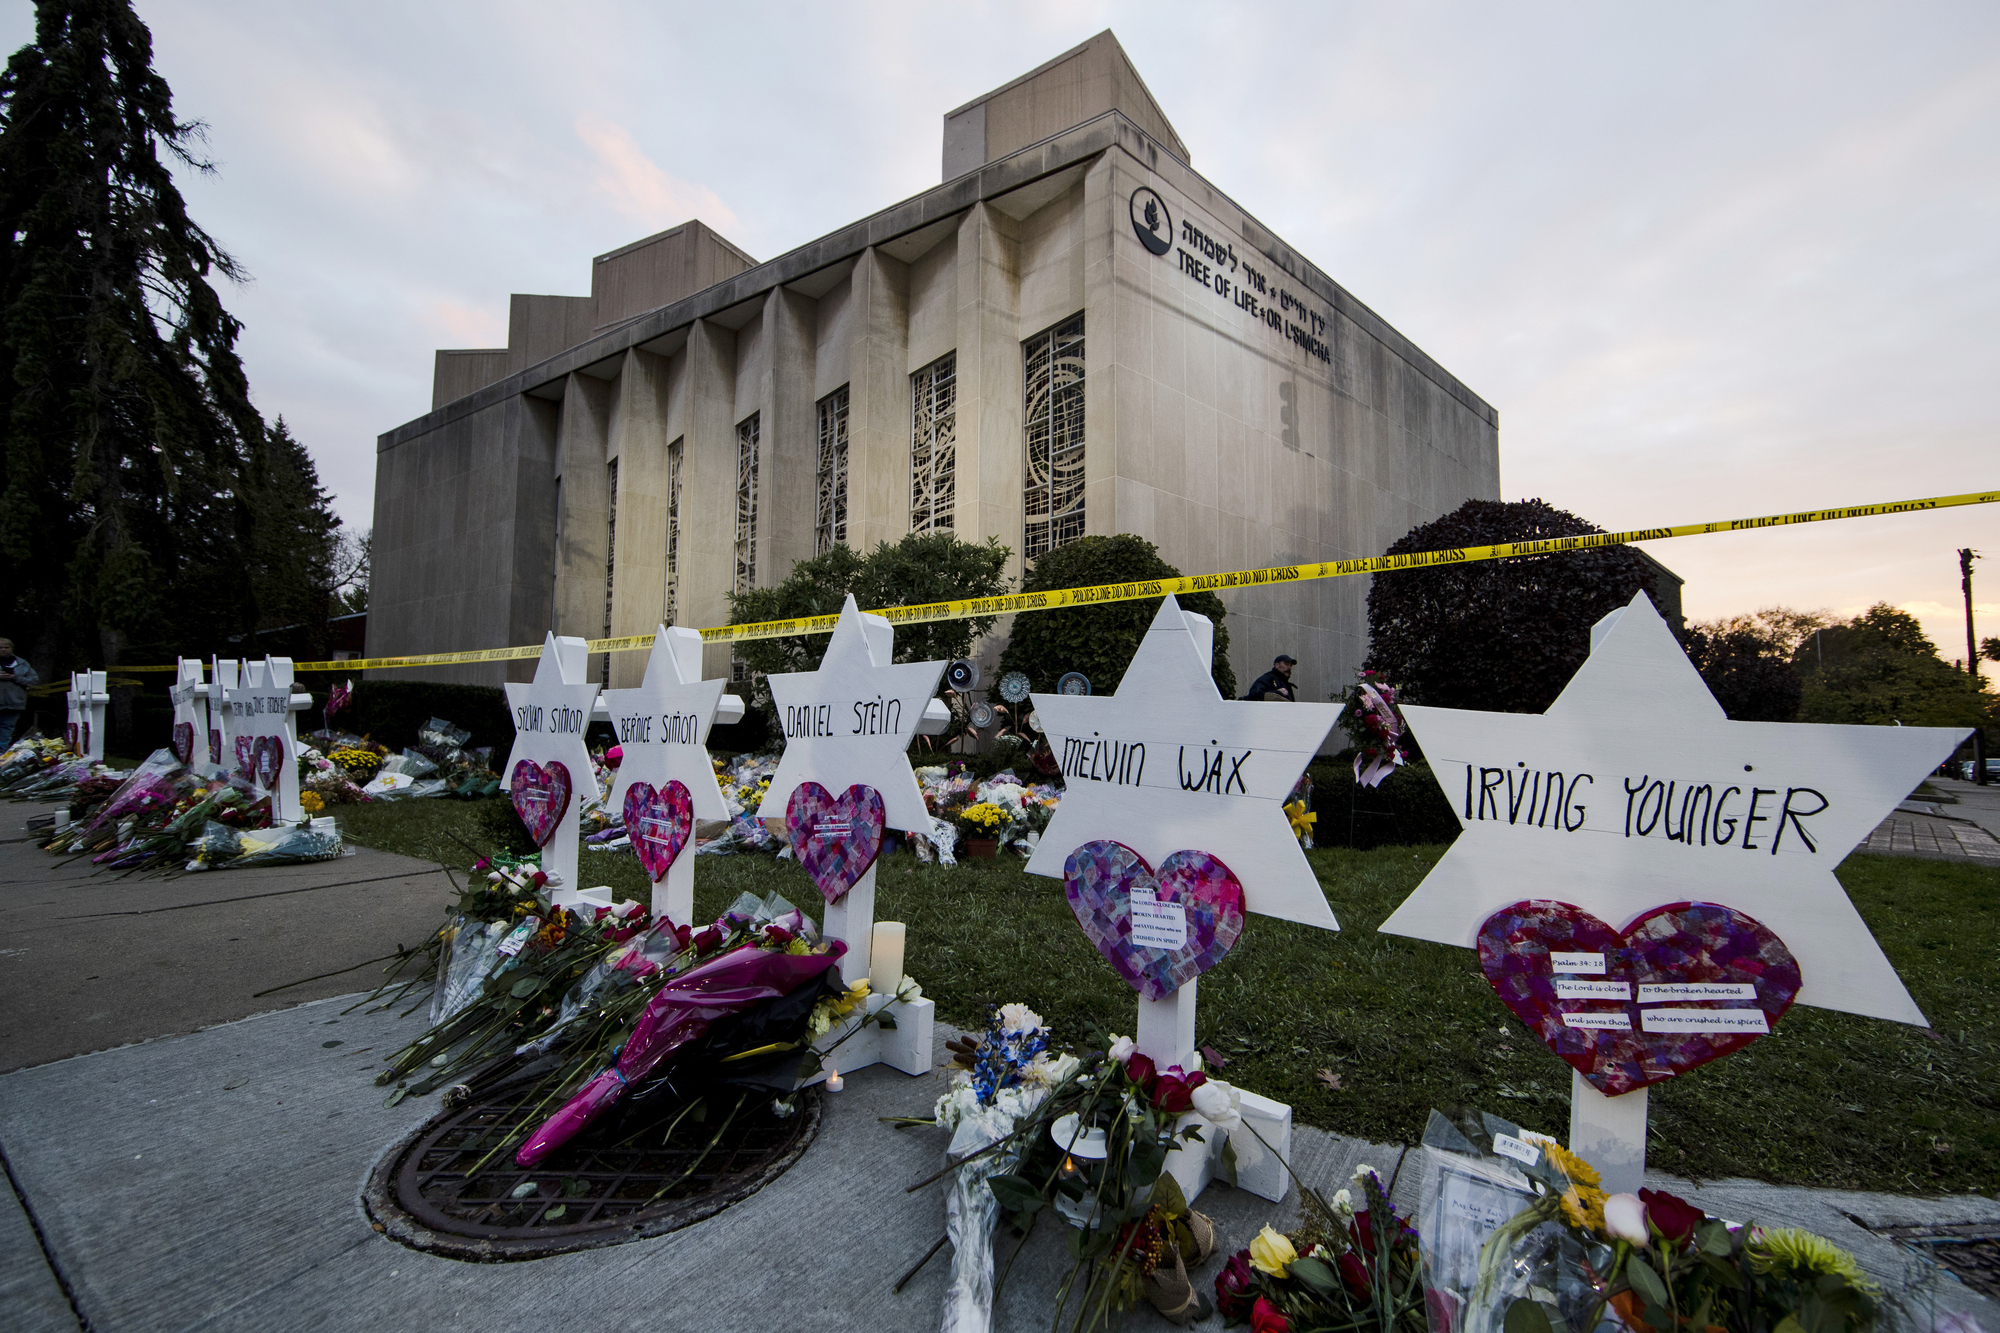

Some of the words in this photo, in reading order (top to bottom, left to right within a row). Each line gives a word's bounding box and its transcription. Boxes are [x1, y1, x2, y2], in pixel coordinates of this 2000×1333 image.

[1182, 219, 1238, 273] לשמחה
[1242, 261, 1267, 296] אור
[1177, 247, 1212, 289] TREE
[1215, 274, 1231, 299] OF
[1234, 285, 1259, 318] LIFE
[1266, 310, 1283, 334] OR
[1285, 319, 1331, 365] L'SIMCHA
[1512, 540, 1551, 555] POLICE
[1554, 537, 1579, 550] LINE
[1603, 531, 1626, 545] NOT
[1630, 527, 1673, 541] CROSS
[1335, 559, 1368, 574] POLICE
[1370, 556, 1391, 570] LINE
[1394, 554, 1407, 568] DO
[1410, 551, 1428, 566] NOT
[1431, 548, 1466, 563] CROSS
[1191, 575, 1219, 590] POLICE
[1220, 572, 1238, 587] LINE
[1239, 571, 1251, 585] DO
[1253, 569, 1268, 583] NOT
[1270, 566, 1299, 581] CROSS
[971, 600, 991, 614] POLICE
[991, 598, 1004, 613] LINE
[1004, 597, 1013, 611] DO
[1013, 595, 1027, 609] NOT
[1026, 593, 1047, 608] CROSS
[1072, 588, 1095, 603] POLICE
[1095, 586, 1111, 600] LINE
[1112, 585, 1121, 599] DO
[1122, 583, 1137, 597] NOT
[1138, 581, 1162, 596] CROSS
[932, 604, 950, 618] CROSS
[517, 704, 543, 733] SYLVAN
[550, 707, 583, 734] SIMON
[621, 714, 652, 743] BERNICE
[661, 714, 697, 745] SIMON
[787, 704, 834, 739] DANIEL
[852, 698, 901, 736] STEIN
[1062, 736, 1146, 787] MELVIN
[1178, 745, 1252, 795] WAX
[1465, 764, 1594, 832] IRVING
[1624, 774, 1830, 856] YOUNGER
[1552, 959, 1578, 967] Psalm
[1603, 985, 1627, 993] close
[1642, 986, 1652, 994] to
[1670, 986, 1703, 995] broken
[1704, 986, 1744, 995] hearted
[1565, 1016, 1585, 1024] and
[1608, 1018, 1631, 1026] those
[1685, 1016, 1722, 1024] crushed
[1724, 1017, 1735, 1025] in
